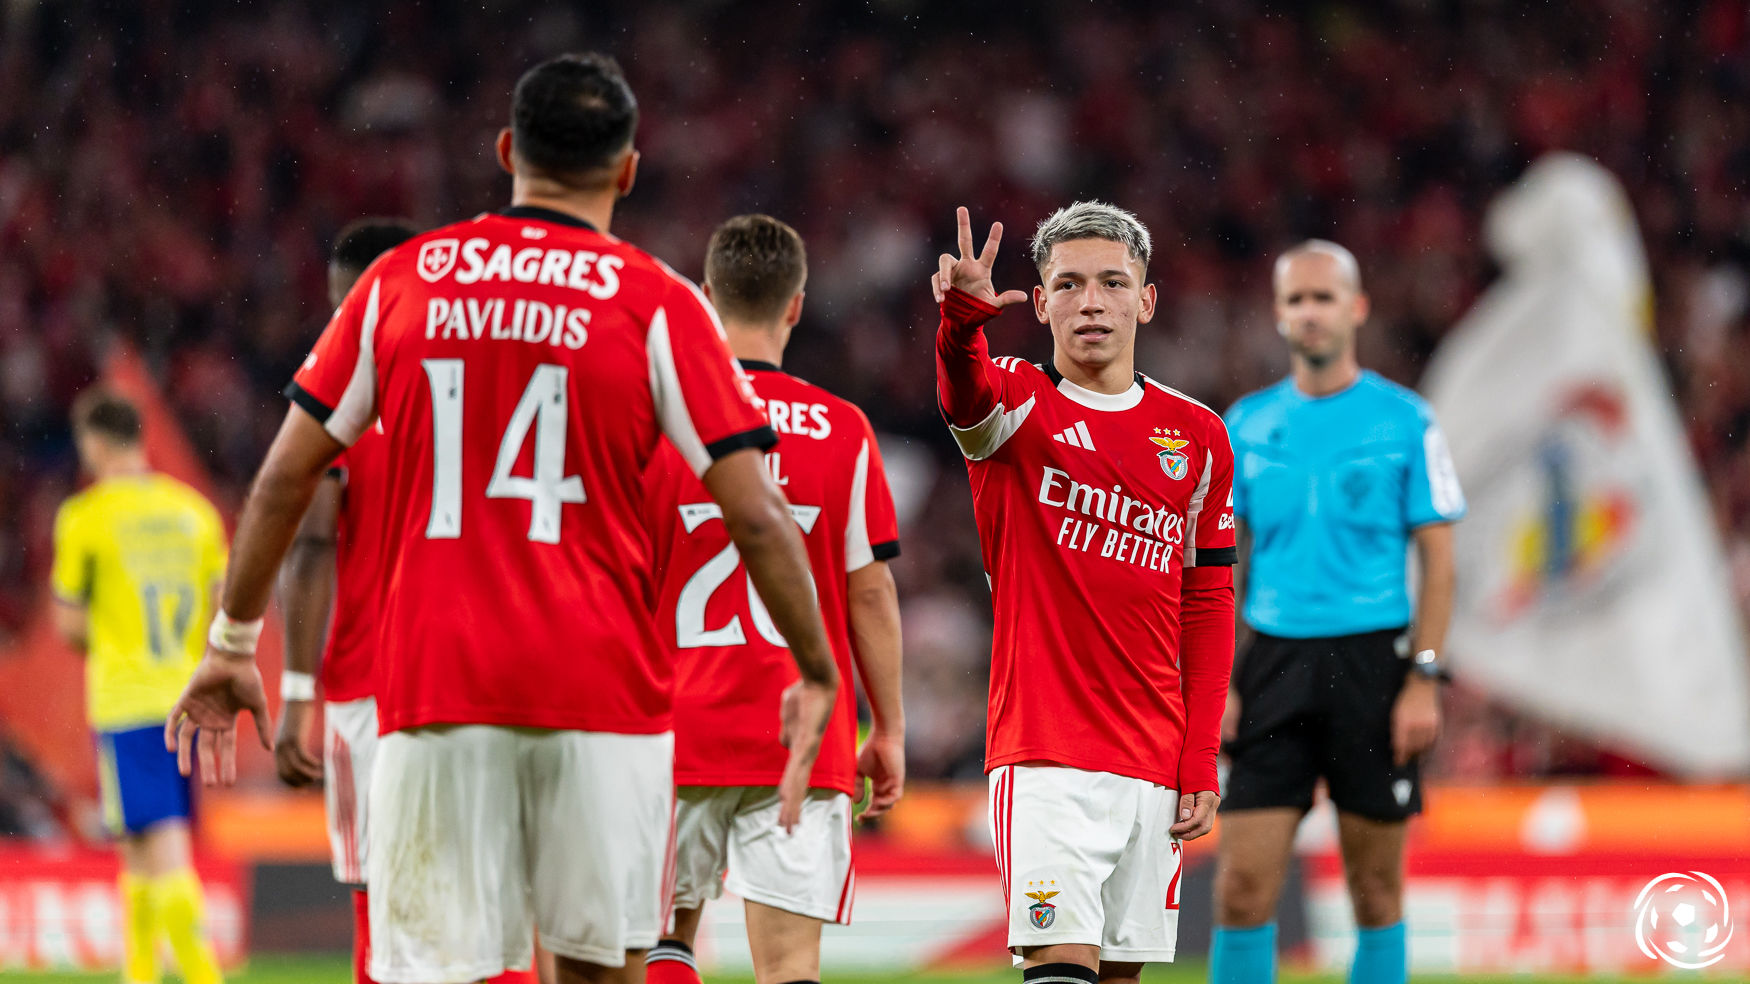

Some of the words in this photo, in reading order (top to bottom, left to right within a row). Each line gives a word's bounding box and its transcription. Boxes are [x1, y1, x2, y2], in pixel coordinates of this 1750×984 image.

[454, 237, 625, 300] SAGRES
[424, 297, 592, 350] PAVLIDIS
[752, 398, 831, 440] RES
[421, 358, 587, 545] 14
[1038, 465, 1185, 545] Emirates
[1056, 516, 1100, 553] FLY
[1100, 528, 1174, 574] BETTER
